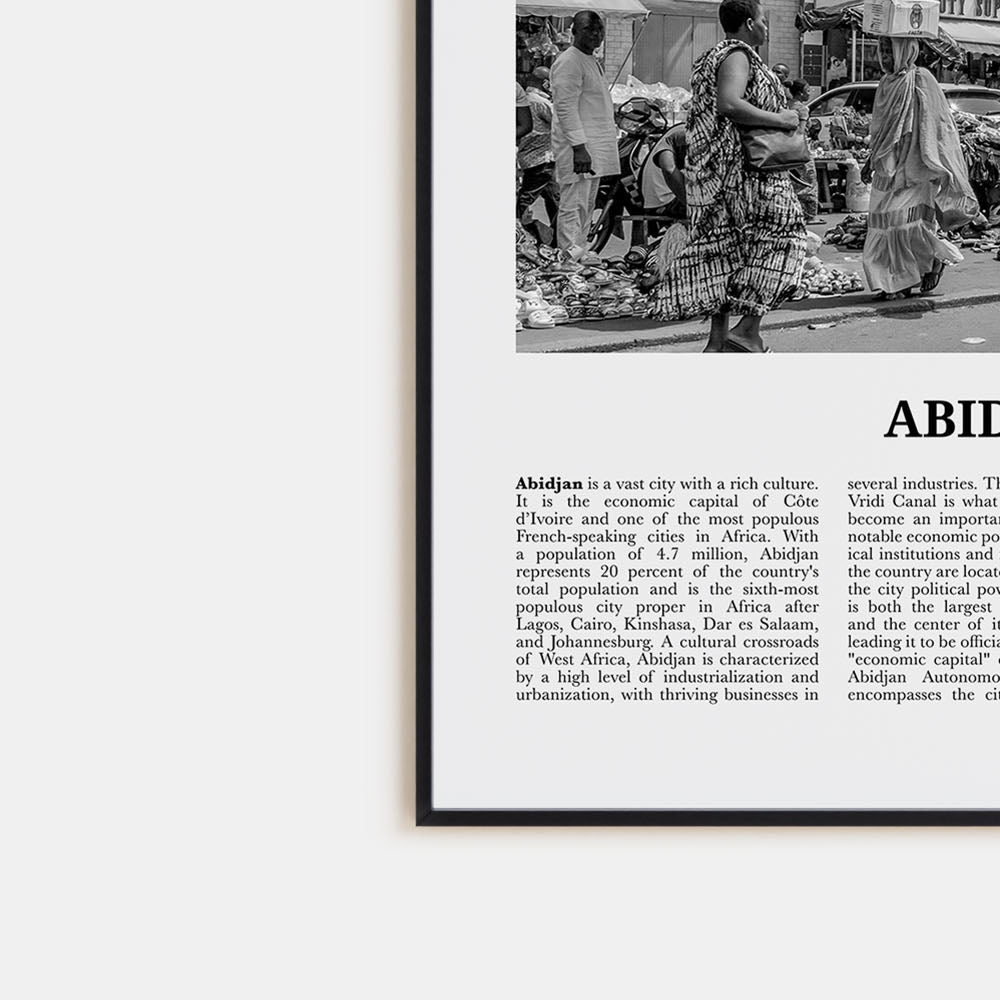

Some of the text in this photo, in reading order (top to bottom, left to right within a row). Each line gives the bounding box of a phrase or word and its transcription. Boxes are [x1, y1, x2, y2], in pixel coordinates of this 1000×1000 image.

[514, 476, 819, 495] Abidjan is a vast city with a rich culture.
[847, 476, 898, 491] several
[902, 476, 978, 491] industries.
[581, 511, 609, 526] and
[616, 515, 645, 526] one
[651, 511, 670, 526] of
[677, 511, 701, 526] the
[708, 514, 744, 526] most
[751, 511, 820, 530] populous
[515, 546, 819, 566] a population of 4.7 million, Abidjan
[847, 546, 874, 561] ical
[879, 546, 961, 561] institutions
[965, 546, 994, 561] and
[516, 581, 819, 600] total population and is the sixth-most
[847, 581, 871, 596] the
[877, 581, 905, 600] city
[911, 581, 970, 600] political
[516, 616, 819, 635] Lagos, Cairo, Kinshasa, Dar es Salaam,
[847, 616, 876, 631] and
[883, 616, 907, 631] the
[913, 619, 961, 631] center
[967, 616, 985, 631] of
[515, 651, 820, 670] of West Africa, Abidjan is characterized
[848, 651, 927, 666] "economic
[933, 651, 991, 670] capital"
[515, 687, 819, 705] urbanization, with thriving businesses in
[847, 691, 942, 705] encompasses
[952, 687, 975, 701] the
